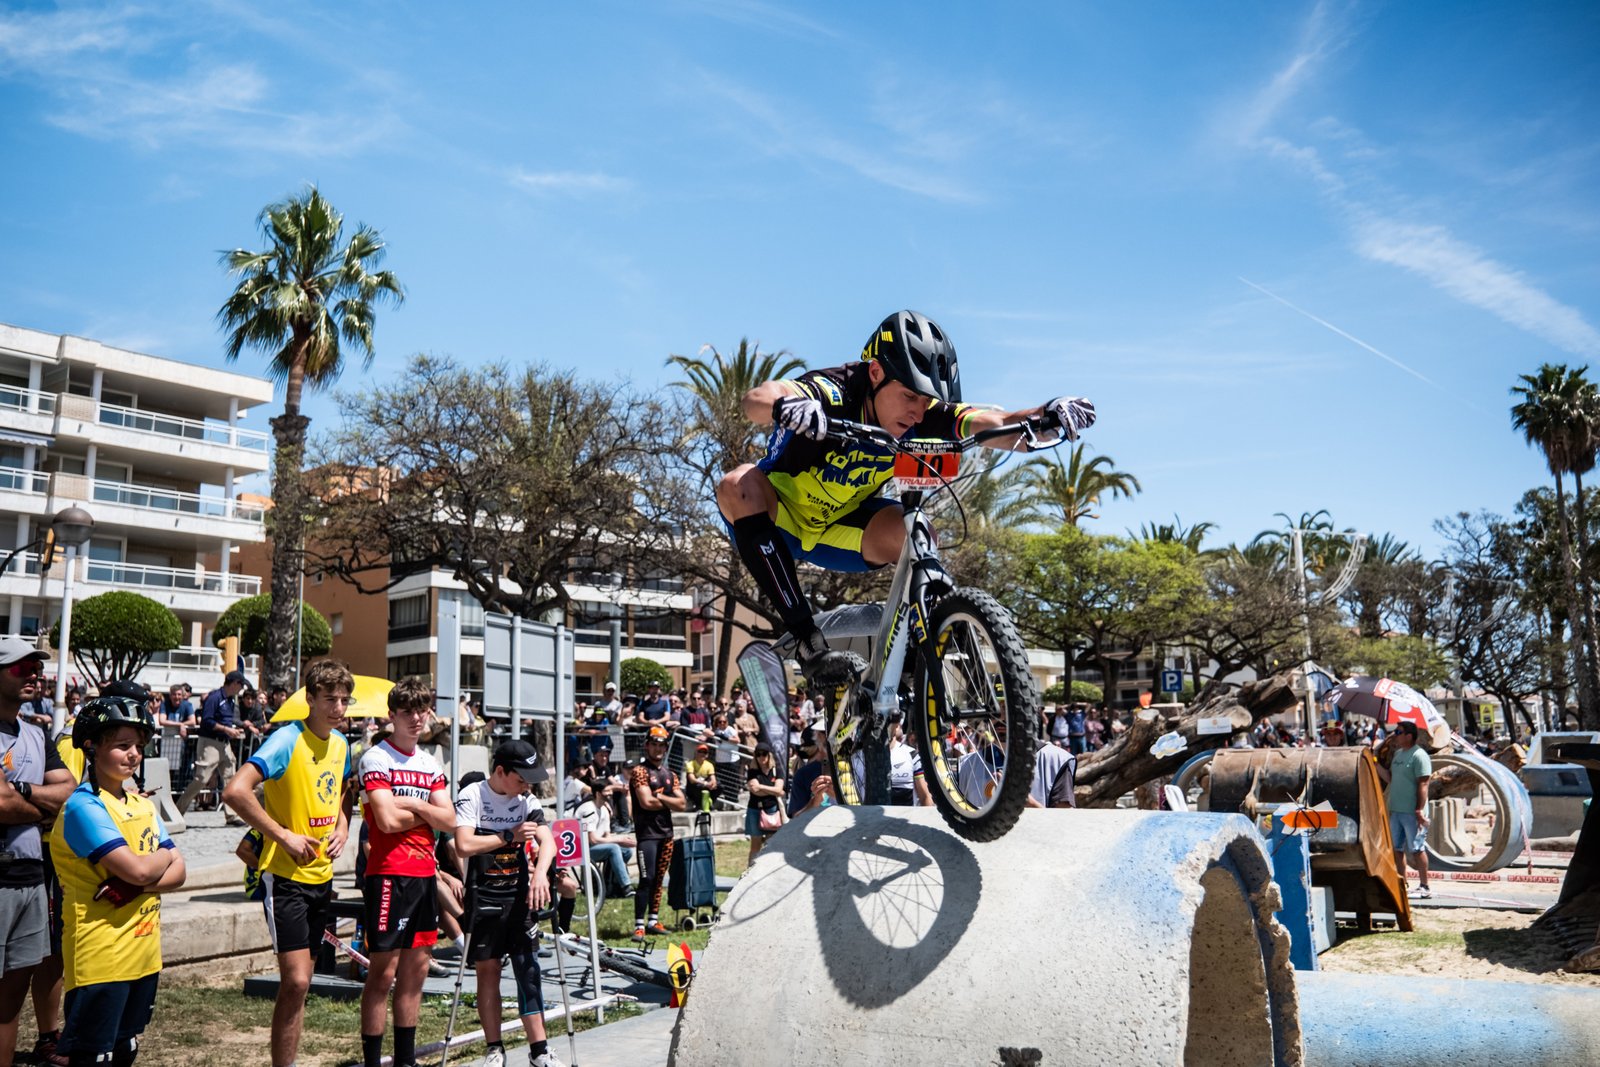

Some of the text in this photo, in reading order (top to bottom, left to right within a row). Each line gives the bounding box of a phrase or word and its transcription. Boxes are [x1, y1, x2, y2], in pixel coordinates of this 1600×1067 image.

[933, 441, 953, 449] ESPAÑA
[914, 454, 943, 478] 10
[1165, 672, 1178, 690] P
[388, 770, 433, 787] BAUHAU
[559, 830, 576, 857] 3
[1451, 873, 1500, 881] BAUHAUS
[1508, 875, 1559, 884] BAUHAUS
[378, 879, 391, 931] BAUHAUS
